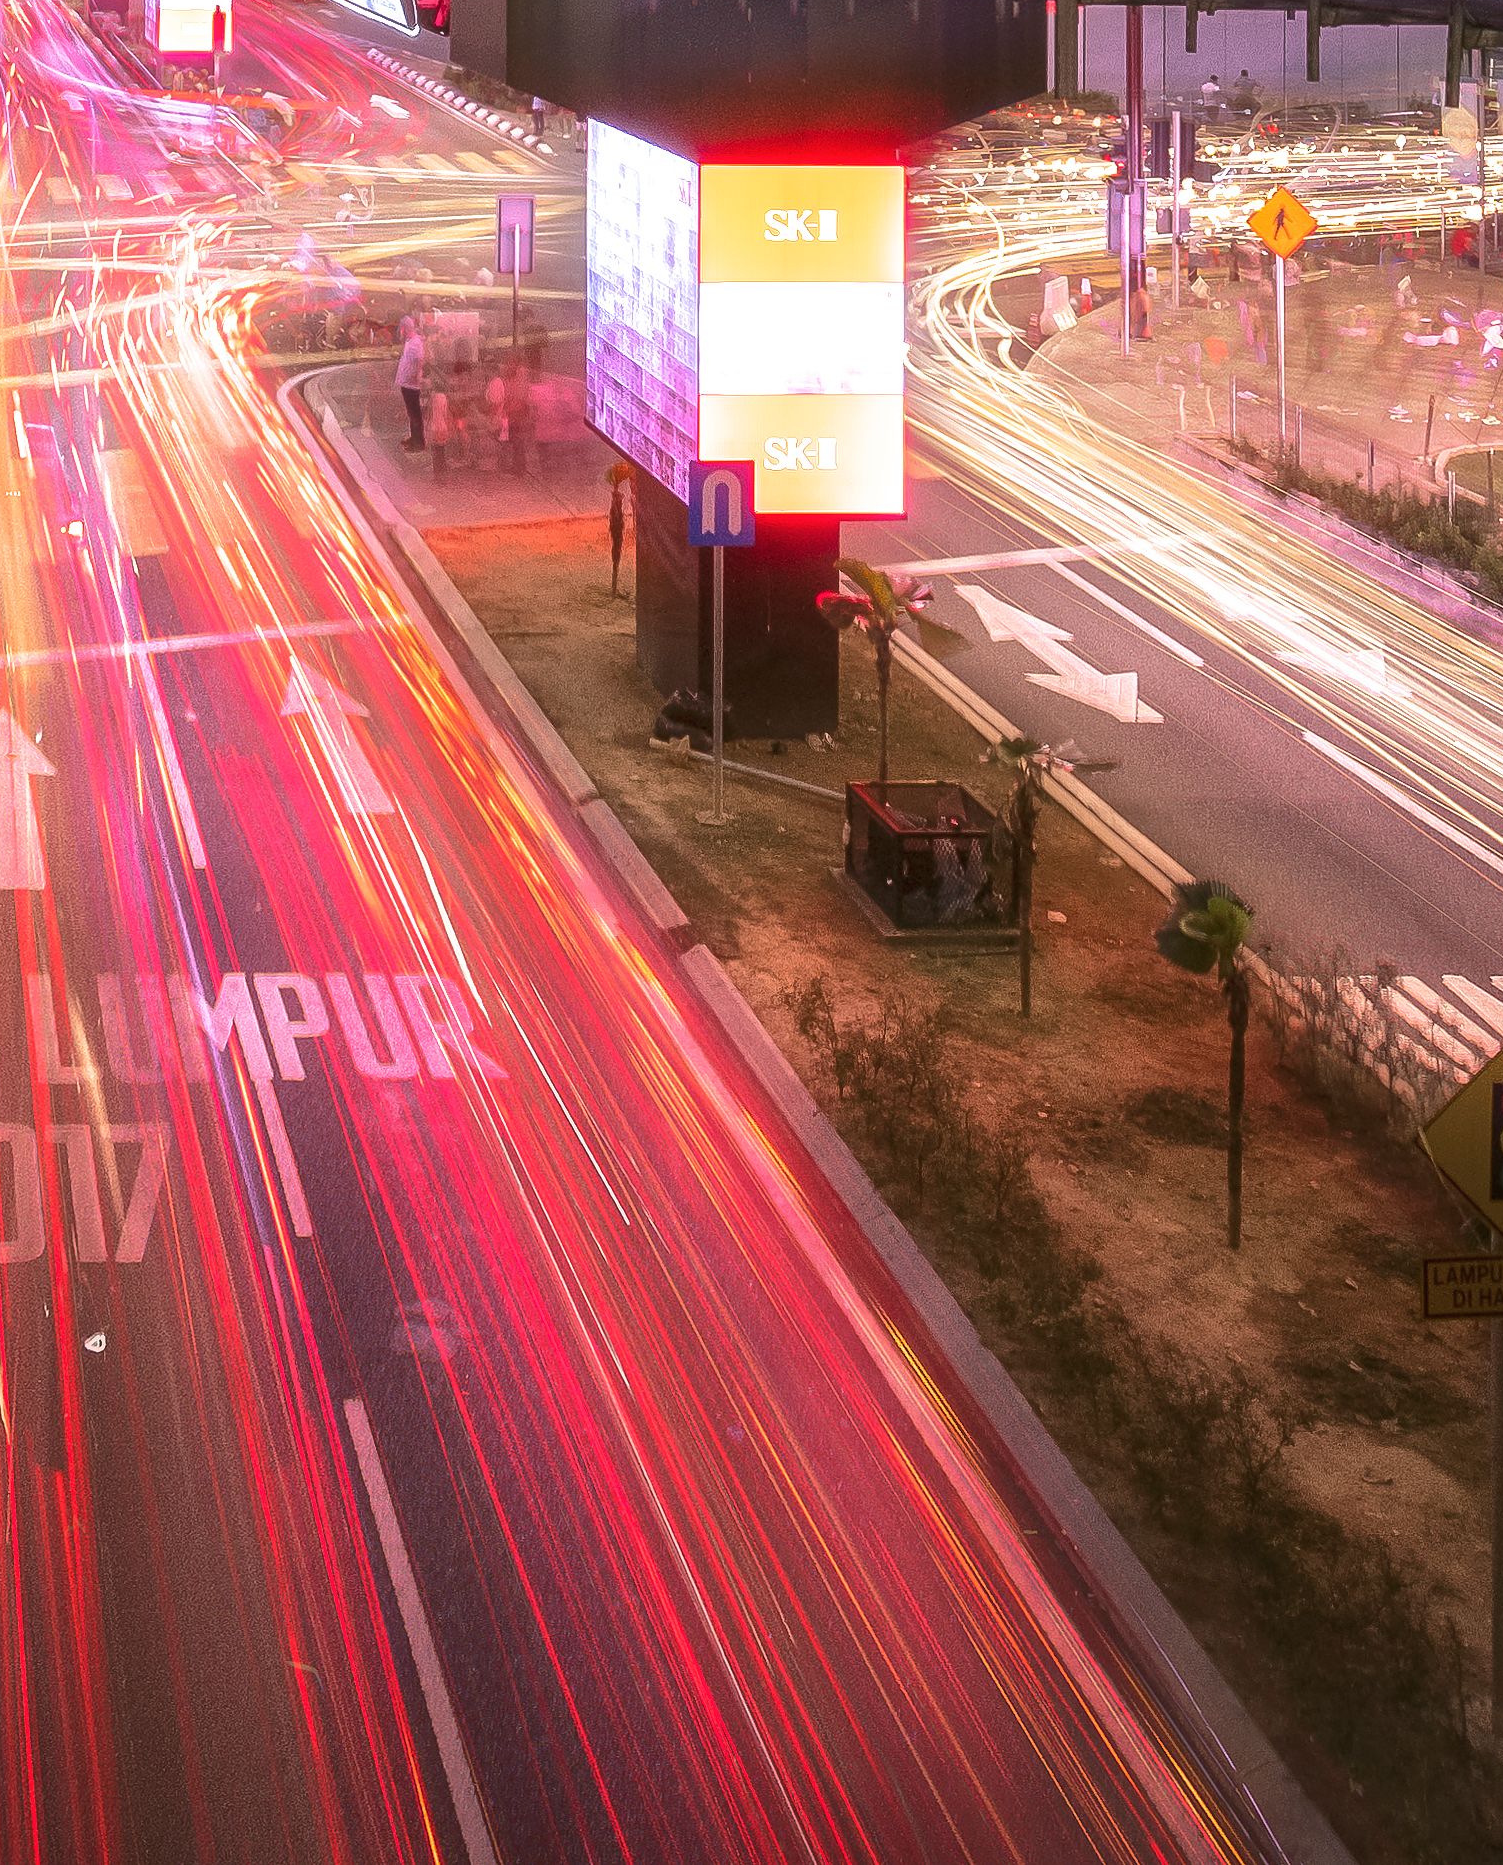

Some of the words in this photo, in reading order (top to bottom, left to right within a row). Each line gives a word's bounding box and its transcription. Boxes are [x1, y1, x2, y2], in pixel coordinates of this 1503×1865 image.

[27, 971, 512, 1083] LUMPUR
[1433, 1264, 1503, 1286] LAMPU
[1451, 1289, 1473, 1309] DI
